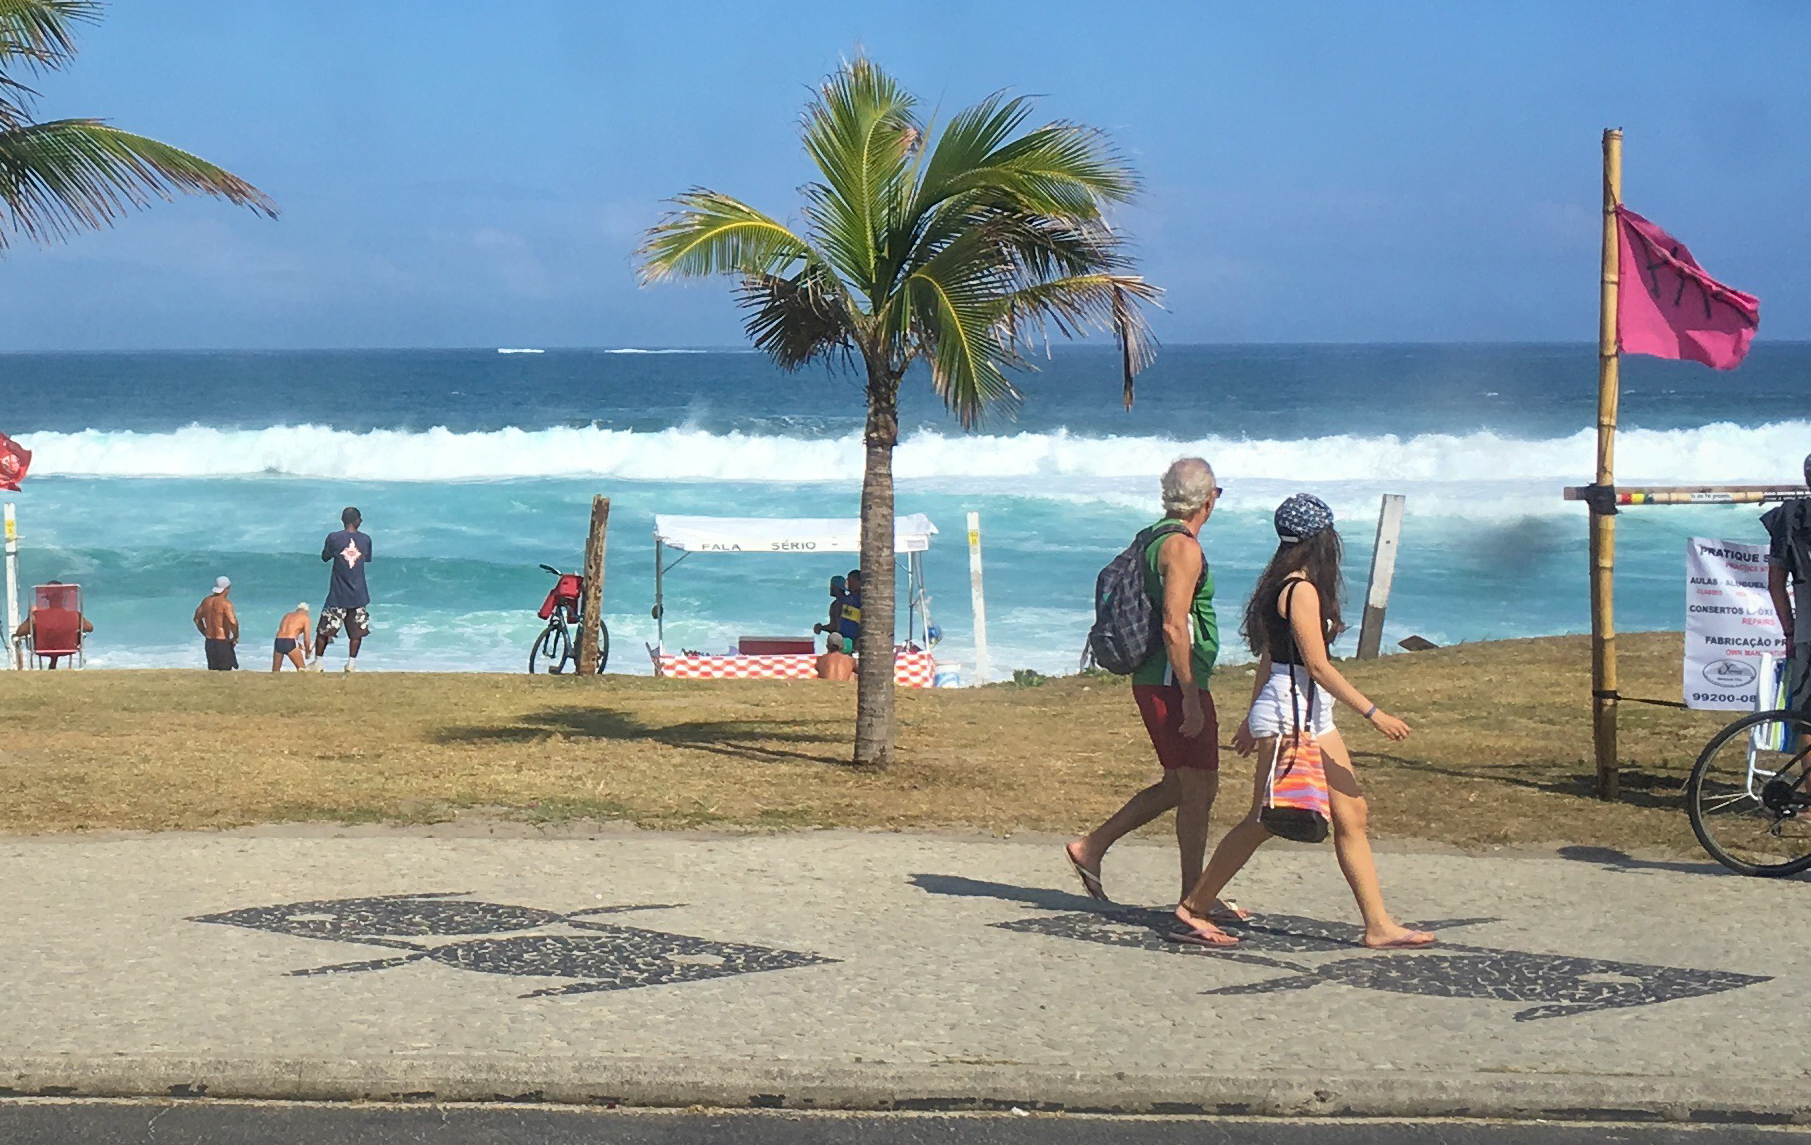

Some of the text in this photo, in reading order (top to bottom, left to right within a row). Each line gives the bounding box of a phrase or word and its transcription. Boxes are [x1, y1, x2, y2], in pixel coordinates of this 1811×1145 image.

[701, 543, 742, 551] FALA
[771, 539, 817, 551] SÉRIO
[1700, 545, 1759, 563] PRATIQUE
[1690, 576, 1718, 586] AULAS
[1689, 604, 1744, 615] CONSERTOS
[1741, 617, 1776, 625] REPAIRS
[1705, 636, 1771, 648] FABRICAÇÃO
[1725, 648, 1742, 656] OWN
[1692, 692, 1757, 703] 99200-08
